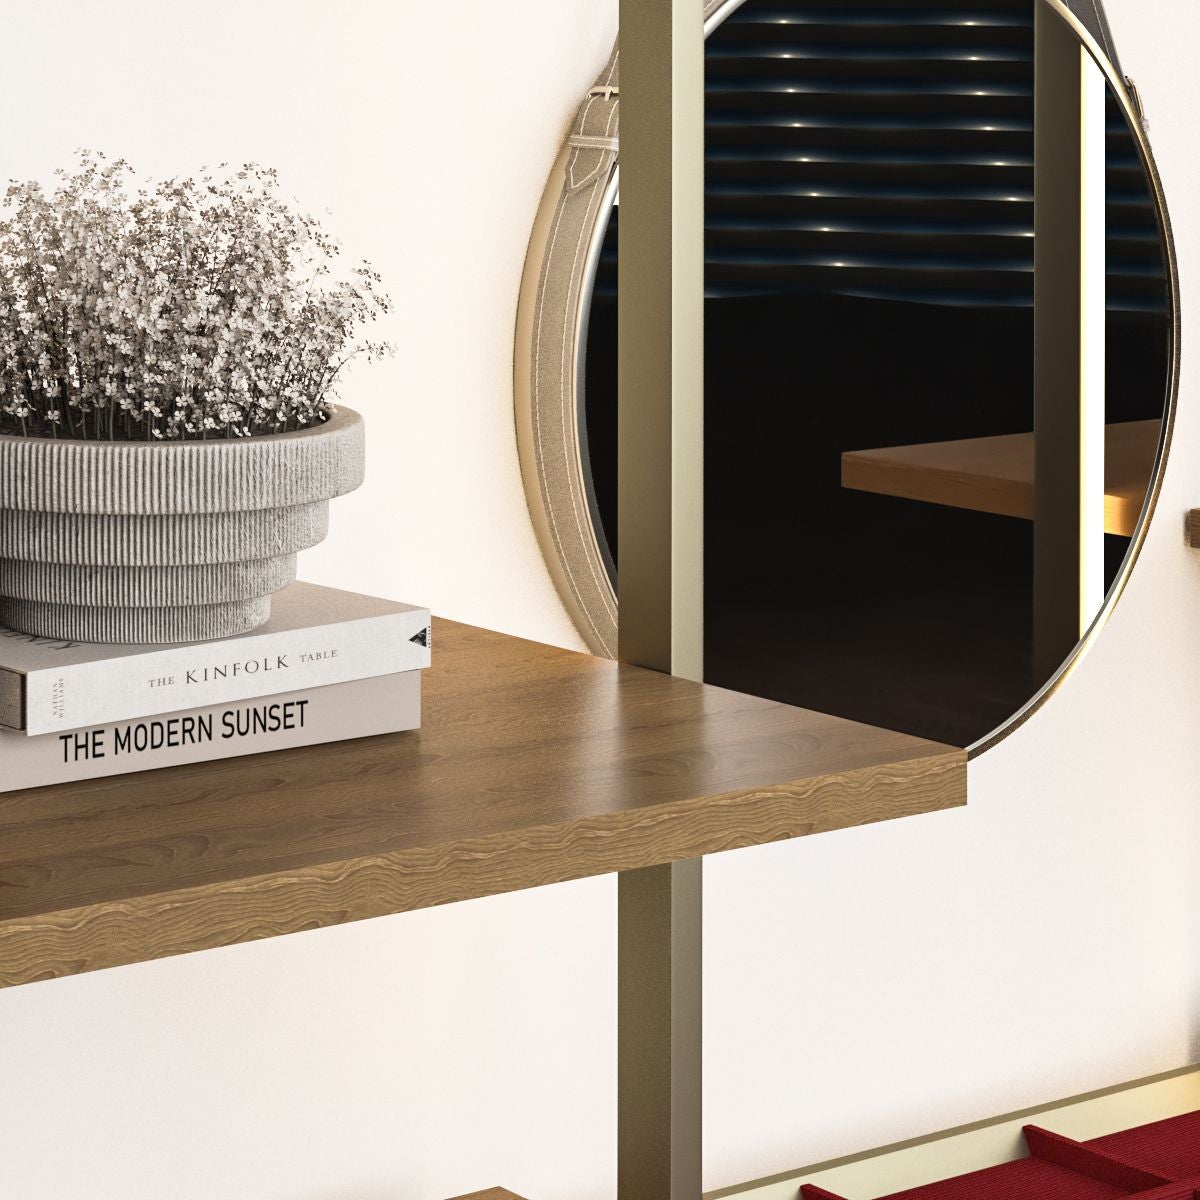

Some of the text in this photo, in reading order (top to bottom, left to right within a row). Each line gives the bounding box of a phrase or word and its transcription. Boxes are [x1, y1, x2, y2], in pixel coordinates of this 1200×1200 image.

[148, 649, 338, 688] THE KINFOLK TABLE
[59, 700, 309, 763] THE MODERN SUNSET
